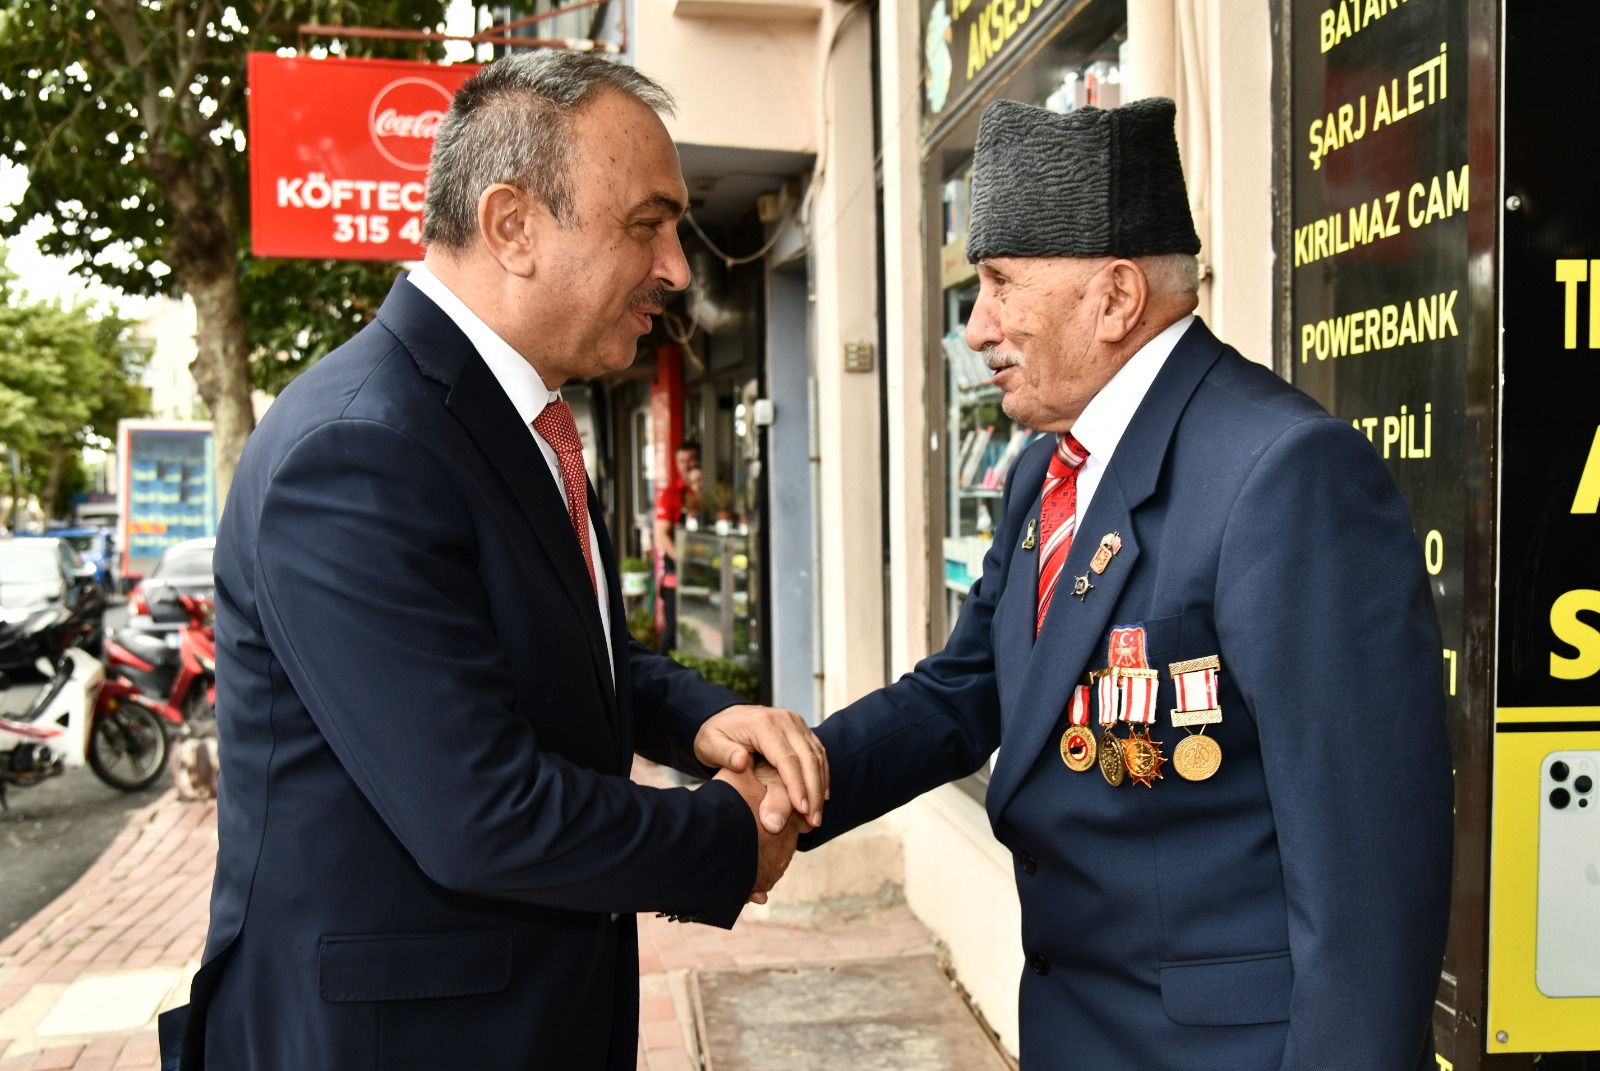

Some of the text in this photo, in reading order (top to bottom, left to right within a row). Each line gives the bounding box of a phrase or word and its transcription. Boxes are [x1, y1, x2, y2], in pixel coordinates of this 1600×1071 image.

[1320, 0, 1408, 53] BATA
[1309, 42, 1447, 170] ŞARJ ALETİ
[277, 172, 428, 212] KÖFTEC
[1295, 164, 1469, 267] KIRILMAZ CAM
[332, 214, 389, 243] 315
[1302, 289, 1458, 364] POWERBANK
[1383, 402, 1431, 459] PİLİ
